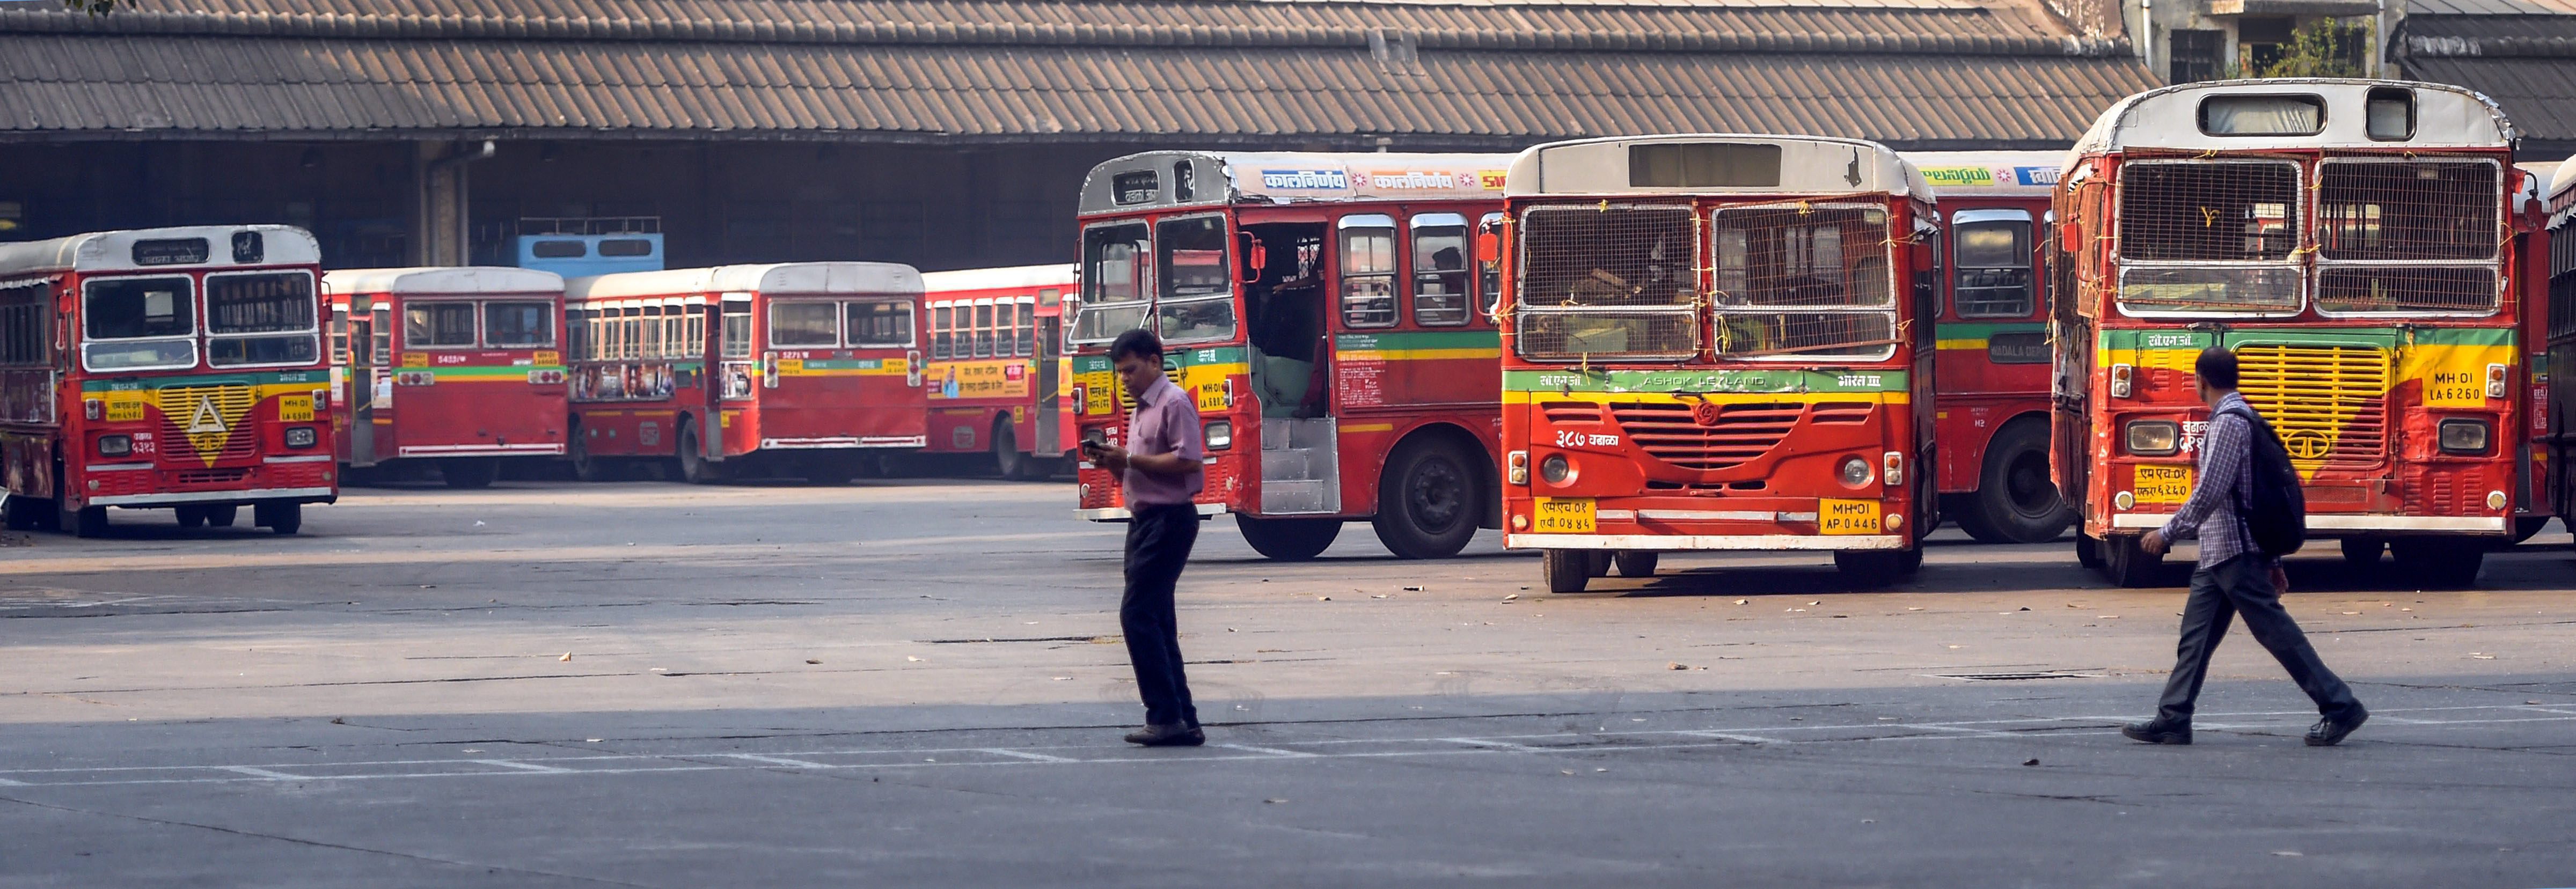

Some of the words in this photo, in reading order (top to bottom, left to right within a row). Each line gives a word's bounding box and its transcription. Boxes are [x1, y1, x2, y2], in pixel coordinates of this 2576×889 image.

[1265, 170, 1346, 188] कालनिर्णय
[1374, 172, 1454, 189] कालनिर्णय
[1991, 346, 2024, 357] WADALA
[1643, 377, 1692, 385] ASHOK
[1699, 377, 1766, 385] LEYLAND
[1838, 375, 1866, 387] भारत
[2435, 372, 2455, 384] MH
[2460, 372, 2472, 384] 01
[2447, 388, 2479, 400] 6260
[2183, 421, 2210, 435] वडाळ
[1556, 430, 1585, 447] ३८७
[1589, 434, 1620, 446] वडाळा
[2158, 484, 2186, 496] ६२६०
[1575, 503, 1587, 513] ०१
[1559, 518, 1590, 530] ०४४६
[1845, 518, 1877, 530] 0446
